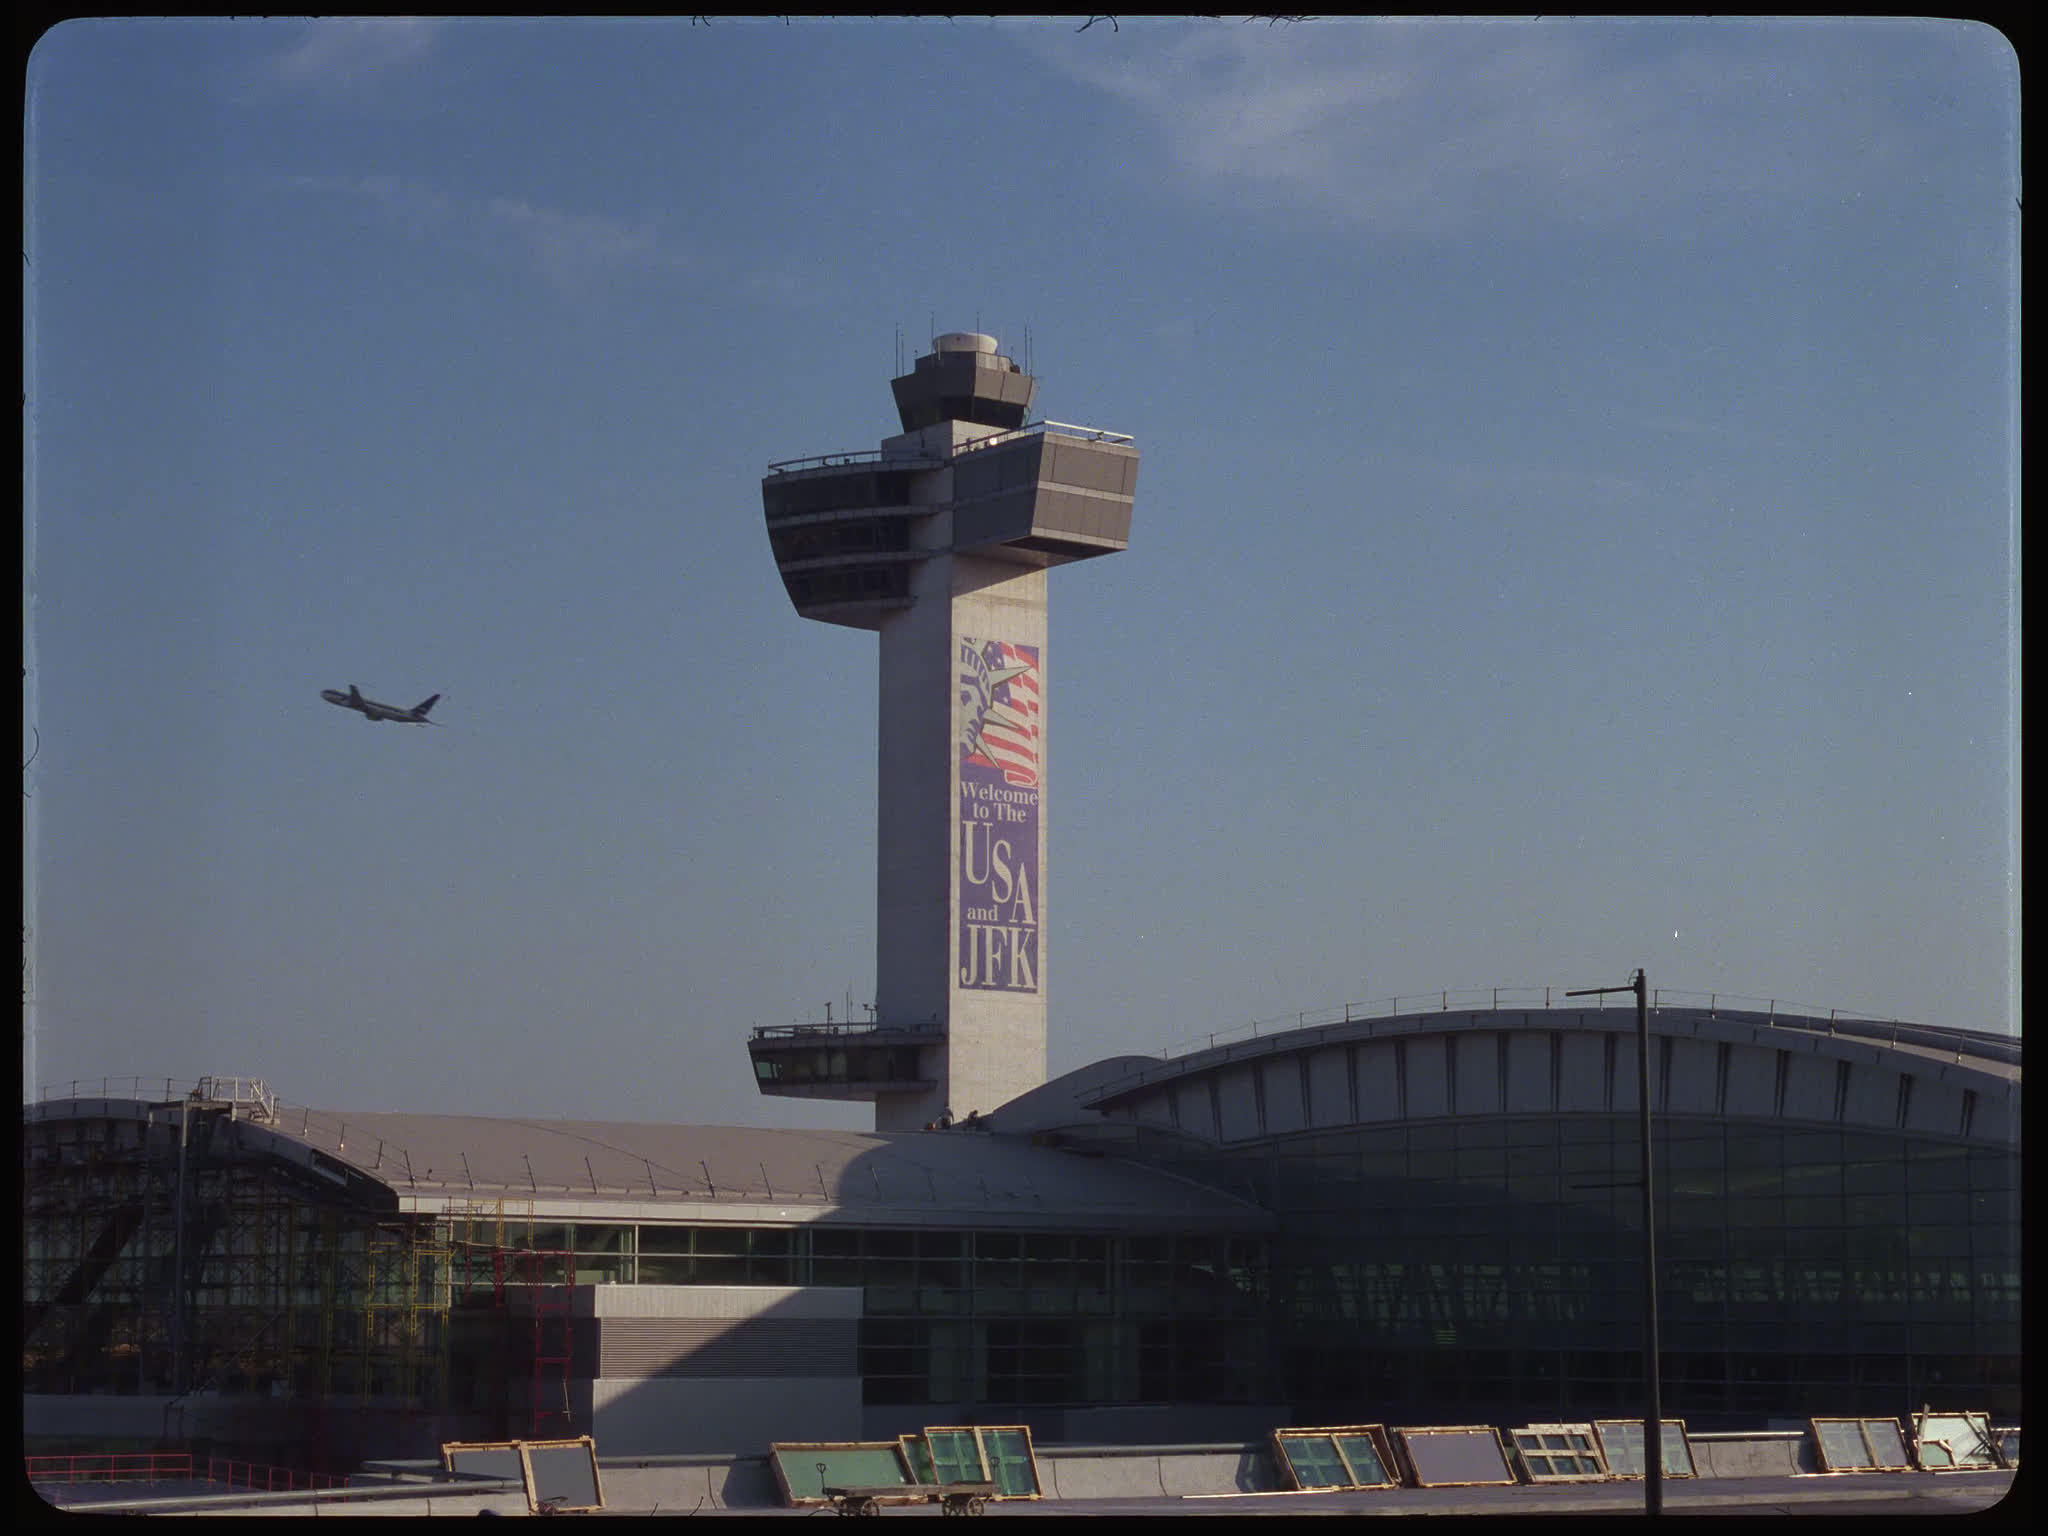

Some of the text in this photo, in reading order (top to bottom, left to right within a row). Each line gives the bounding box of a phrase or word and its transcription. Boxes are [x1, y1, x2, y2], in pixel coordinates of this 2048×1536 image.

[960, 782, 1039, 806] Welcome
[973, 802, 1027, 823] to The
[962, 820, 1037, 925] USA
[967, 904, 999, 921] and
[961, 923, 1037, 989] JFK
